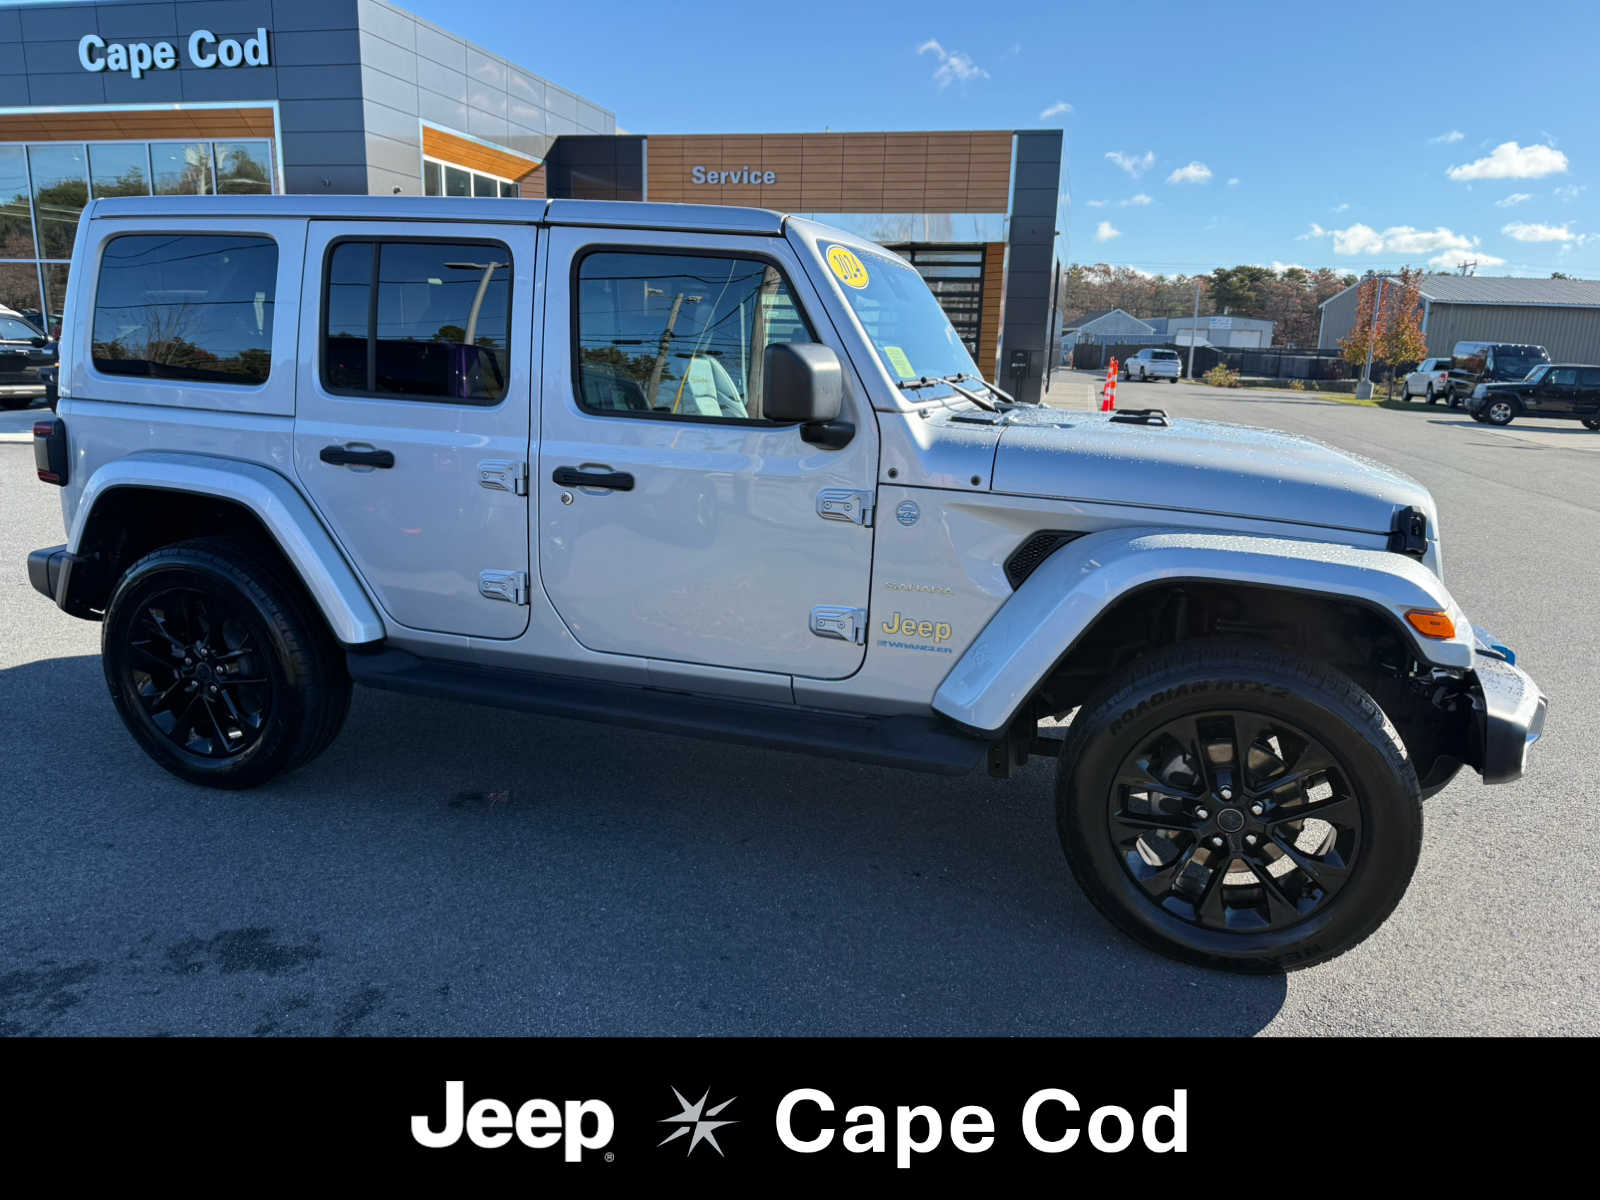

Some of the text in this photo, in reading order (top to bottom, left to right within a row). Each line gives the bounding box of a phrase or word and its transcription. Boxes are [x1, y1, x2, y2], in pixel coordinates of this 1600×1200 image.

[78, 27, 269, 79] Cape Cod
[691, 165, 776, 185] Service
[833, 254, 864, 280] 2024
[881, 611, 953, 644] Jeep
